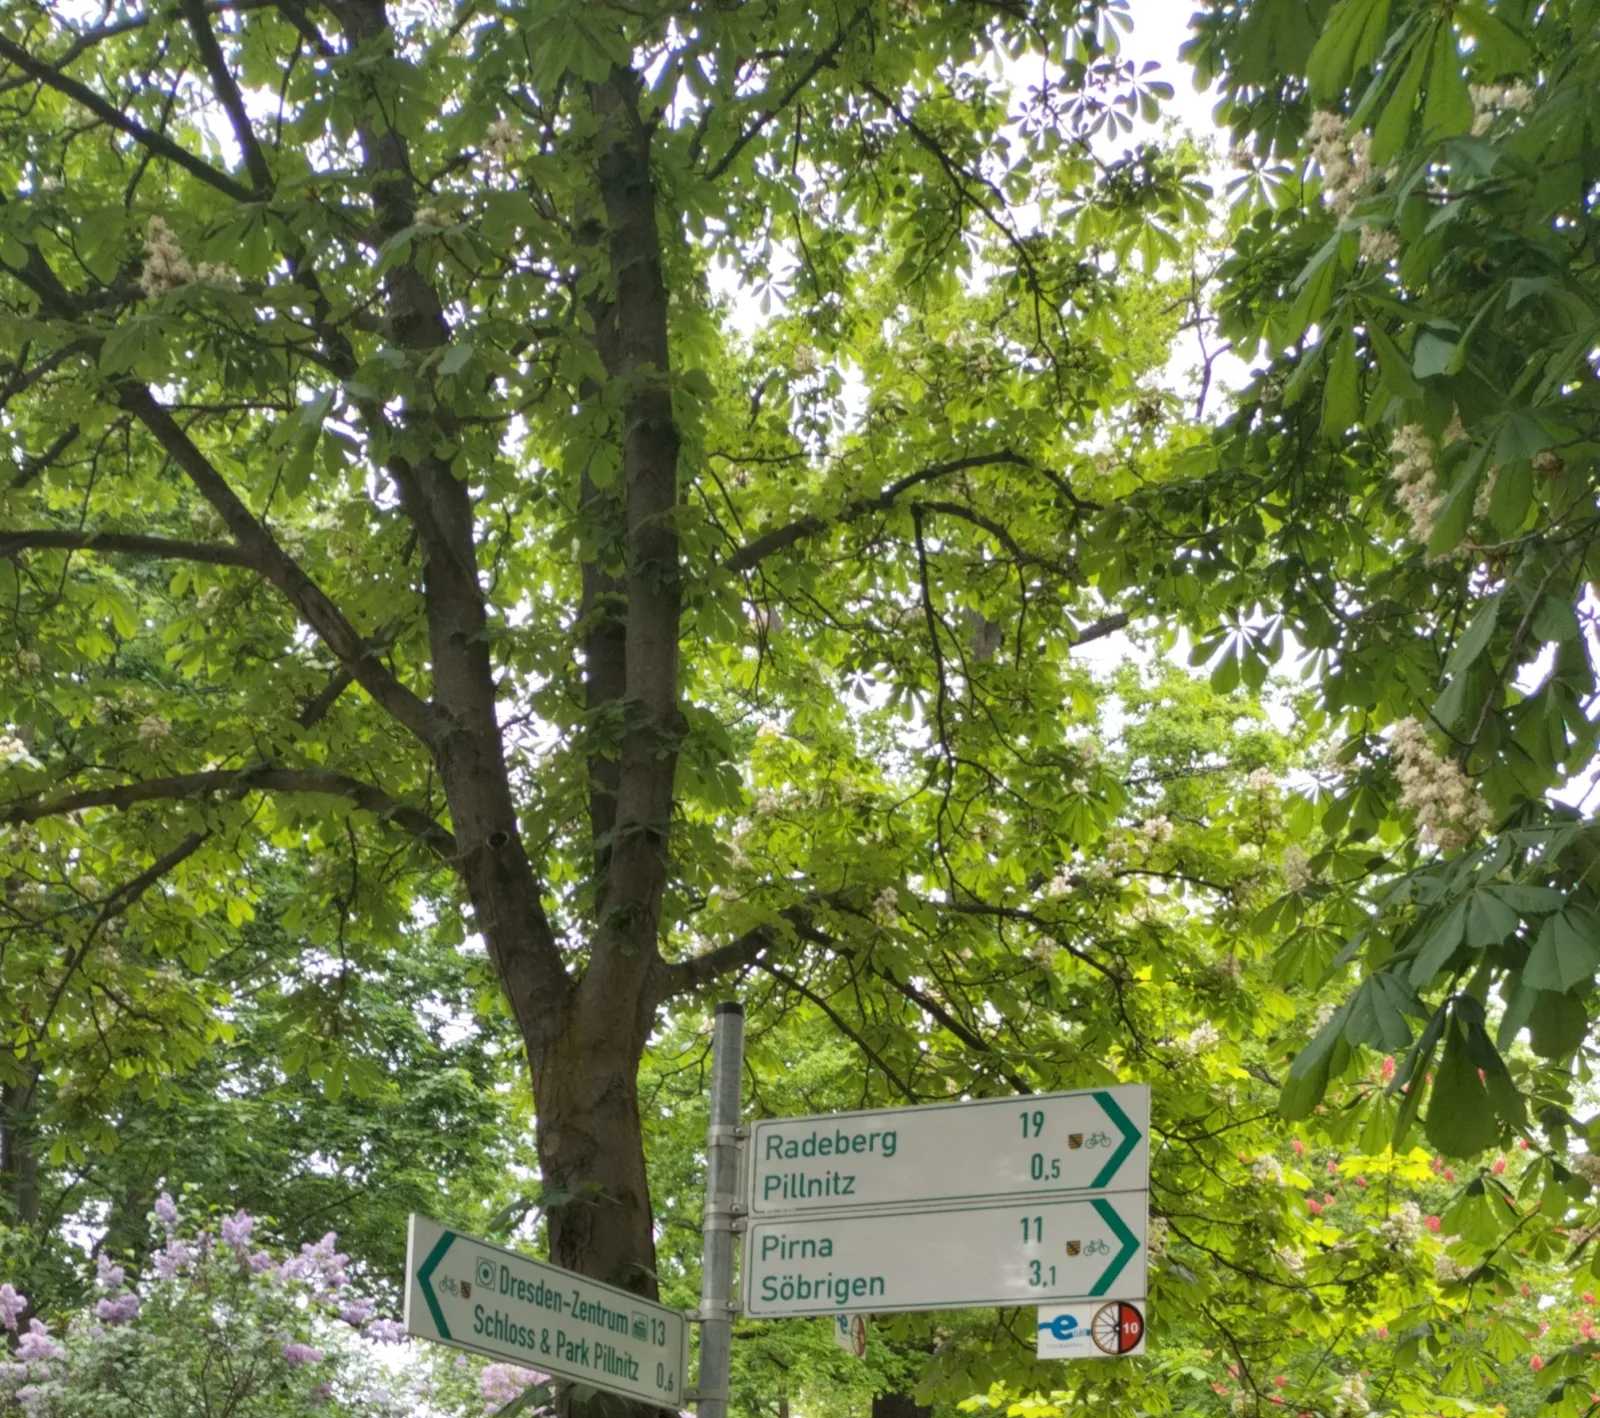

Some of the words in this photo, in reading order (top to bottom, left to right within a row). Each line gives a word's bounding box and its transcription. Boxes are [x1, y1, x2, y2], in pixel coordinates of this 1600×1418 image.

[766, 1129, 897, 1160] Radeberg
[1019, 1110, 1045, 1138] 19
[764, 1170, 856, 1200] Pillnitz
[1030, 1153, 1061, 1181] 0,5
[761, 1234, 833, 1261] Pirna
[1020, 1216, 1043, 1244] 11
[500, 1264, 629, 1336] Dresden-Zentrum
[650, 1318, 666, 1347] 13
[761, 1272, 885, 1305] Söbrigen
[1028, 1260, 1057, 1288] 3,1
[473, 1304, 536, 1350] Schloss
[540, 1328, 551, 1355] &
[556, 1330, 590, 1367] Park
[594, 1341, 639, 1381] Pillnitz
[656, 1362, 674, 1392] 0,6
[1122, 1322, 1139, 1334] 10
